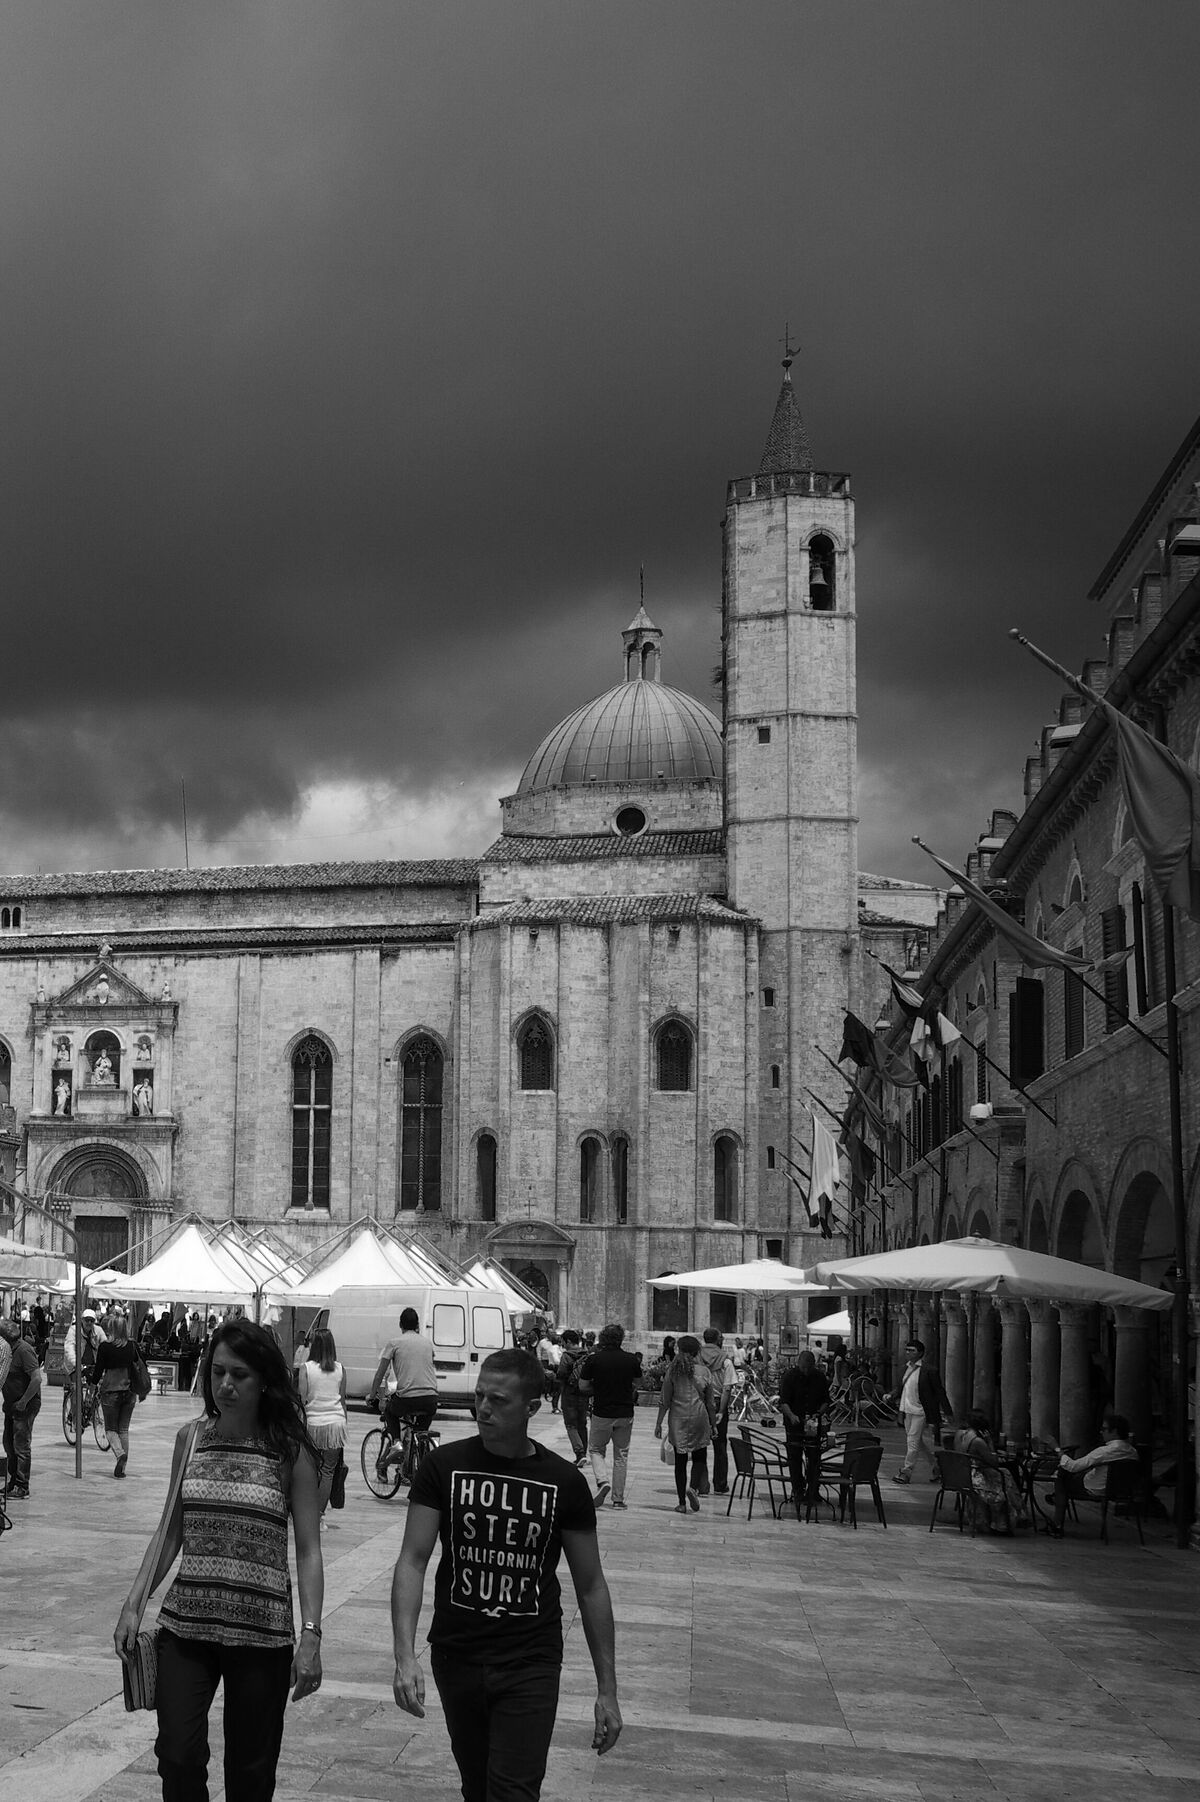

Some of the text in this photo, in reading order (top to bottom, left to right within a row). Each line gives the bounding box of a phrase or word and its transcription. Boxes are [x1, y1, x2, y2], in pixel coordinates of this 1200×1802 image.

[459, 1478, 548, 1518] HOLLI
[463, 1512, 542, 1548] STER
[459, 1544, 538, 1570] CALIFORNIA
[461, 1567, 531, 1604] SURF
